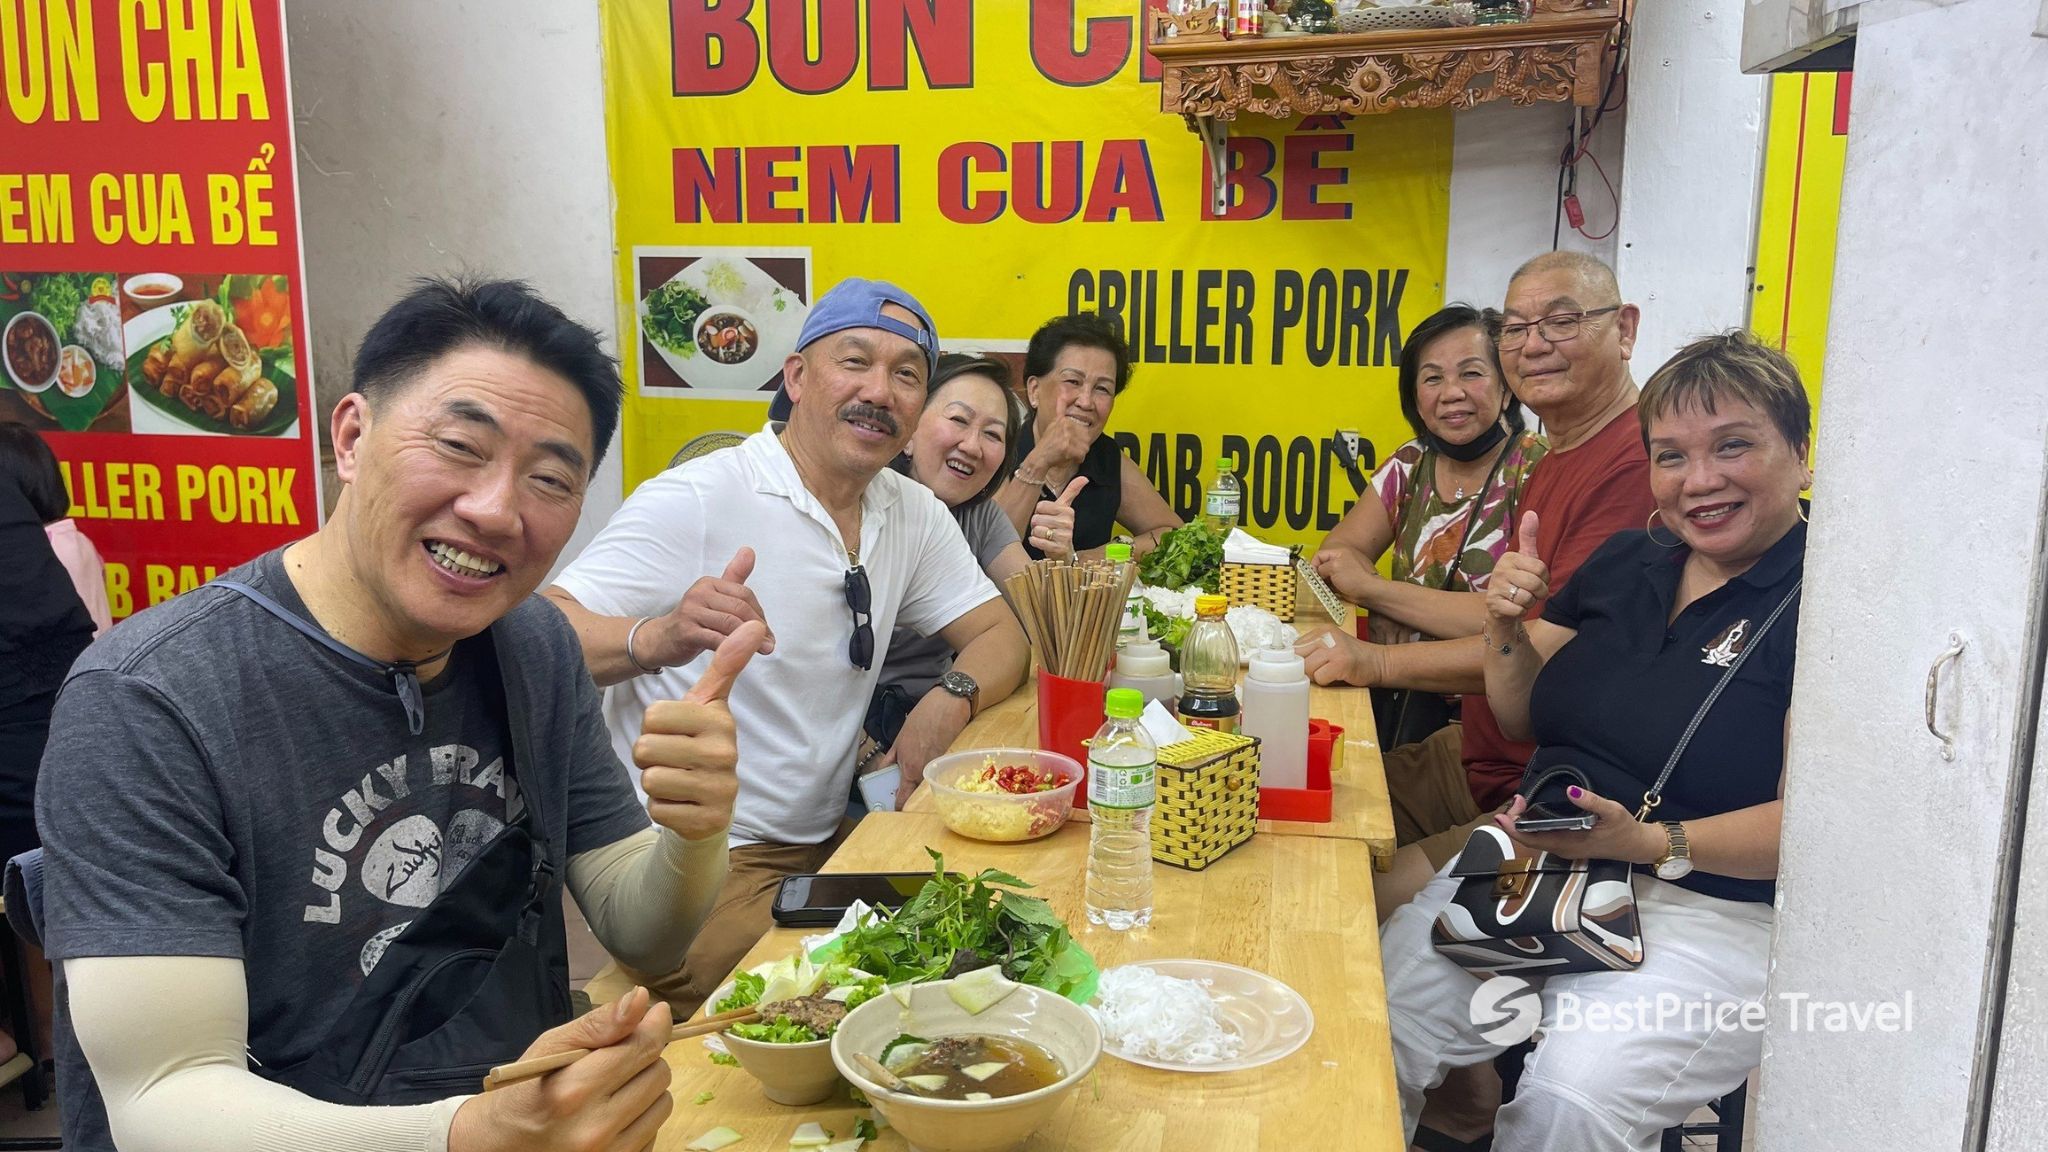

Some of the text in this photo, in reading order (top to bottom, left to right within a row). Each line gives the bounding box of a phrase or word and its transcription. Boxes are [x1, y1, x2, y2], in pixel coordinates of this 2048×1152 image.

[90, 173, 195, 245] CUA
[207, 142, 278, 246] BỂ
[672, 144, 901, 224] NEM
[937, 139, 1165, 224] CUA
[1271, 268, 1409, 367] PORK
[176, 464, 300, 525] PORK
[303, 754, 411, 925] LUCKY
